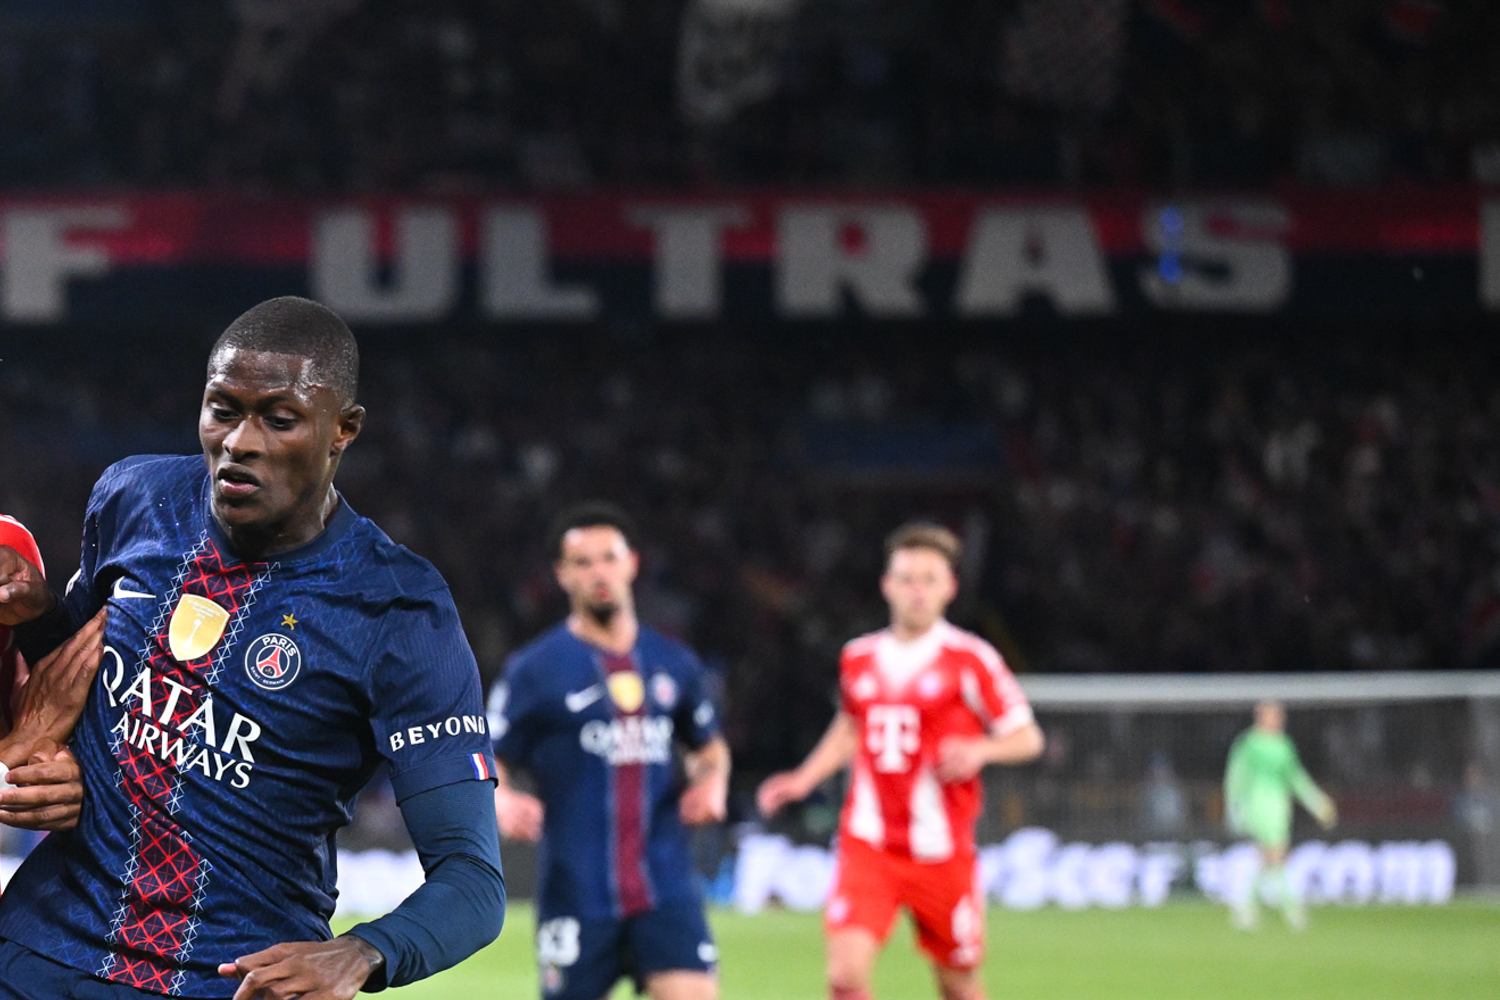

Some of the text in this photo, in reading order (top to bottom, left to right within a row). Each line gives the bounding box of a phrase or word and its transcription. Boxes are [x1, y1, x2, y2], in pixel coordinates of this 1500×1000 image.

[308, 203, 1292, 320] ULTRAS
[262, 636, 296, 656] PARIS
[102, 645, 261, 763] QATAR
[389, 715, 486, 752] BEYOND
[111, 711, 254, 789] AIRWAYS
